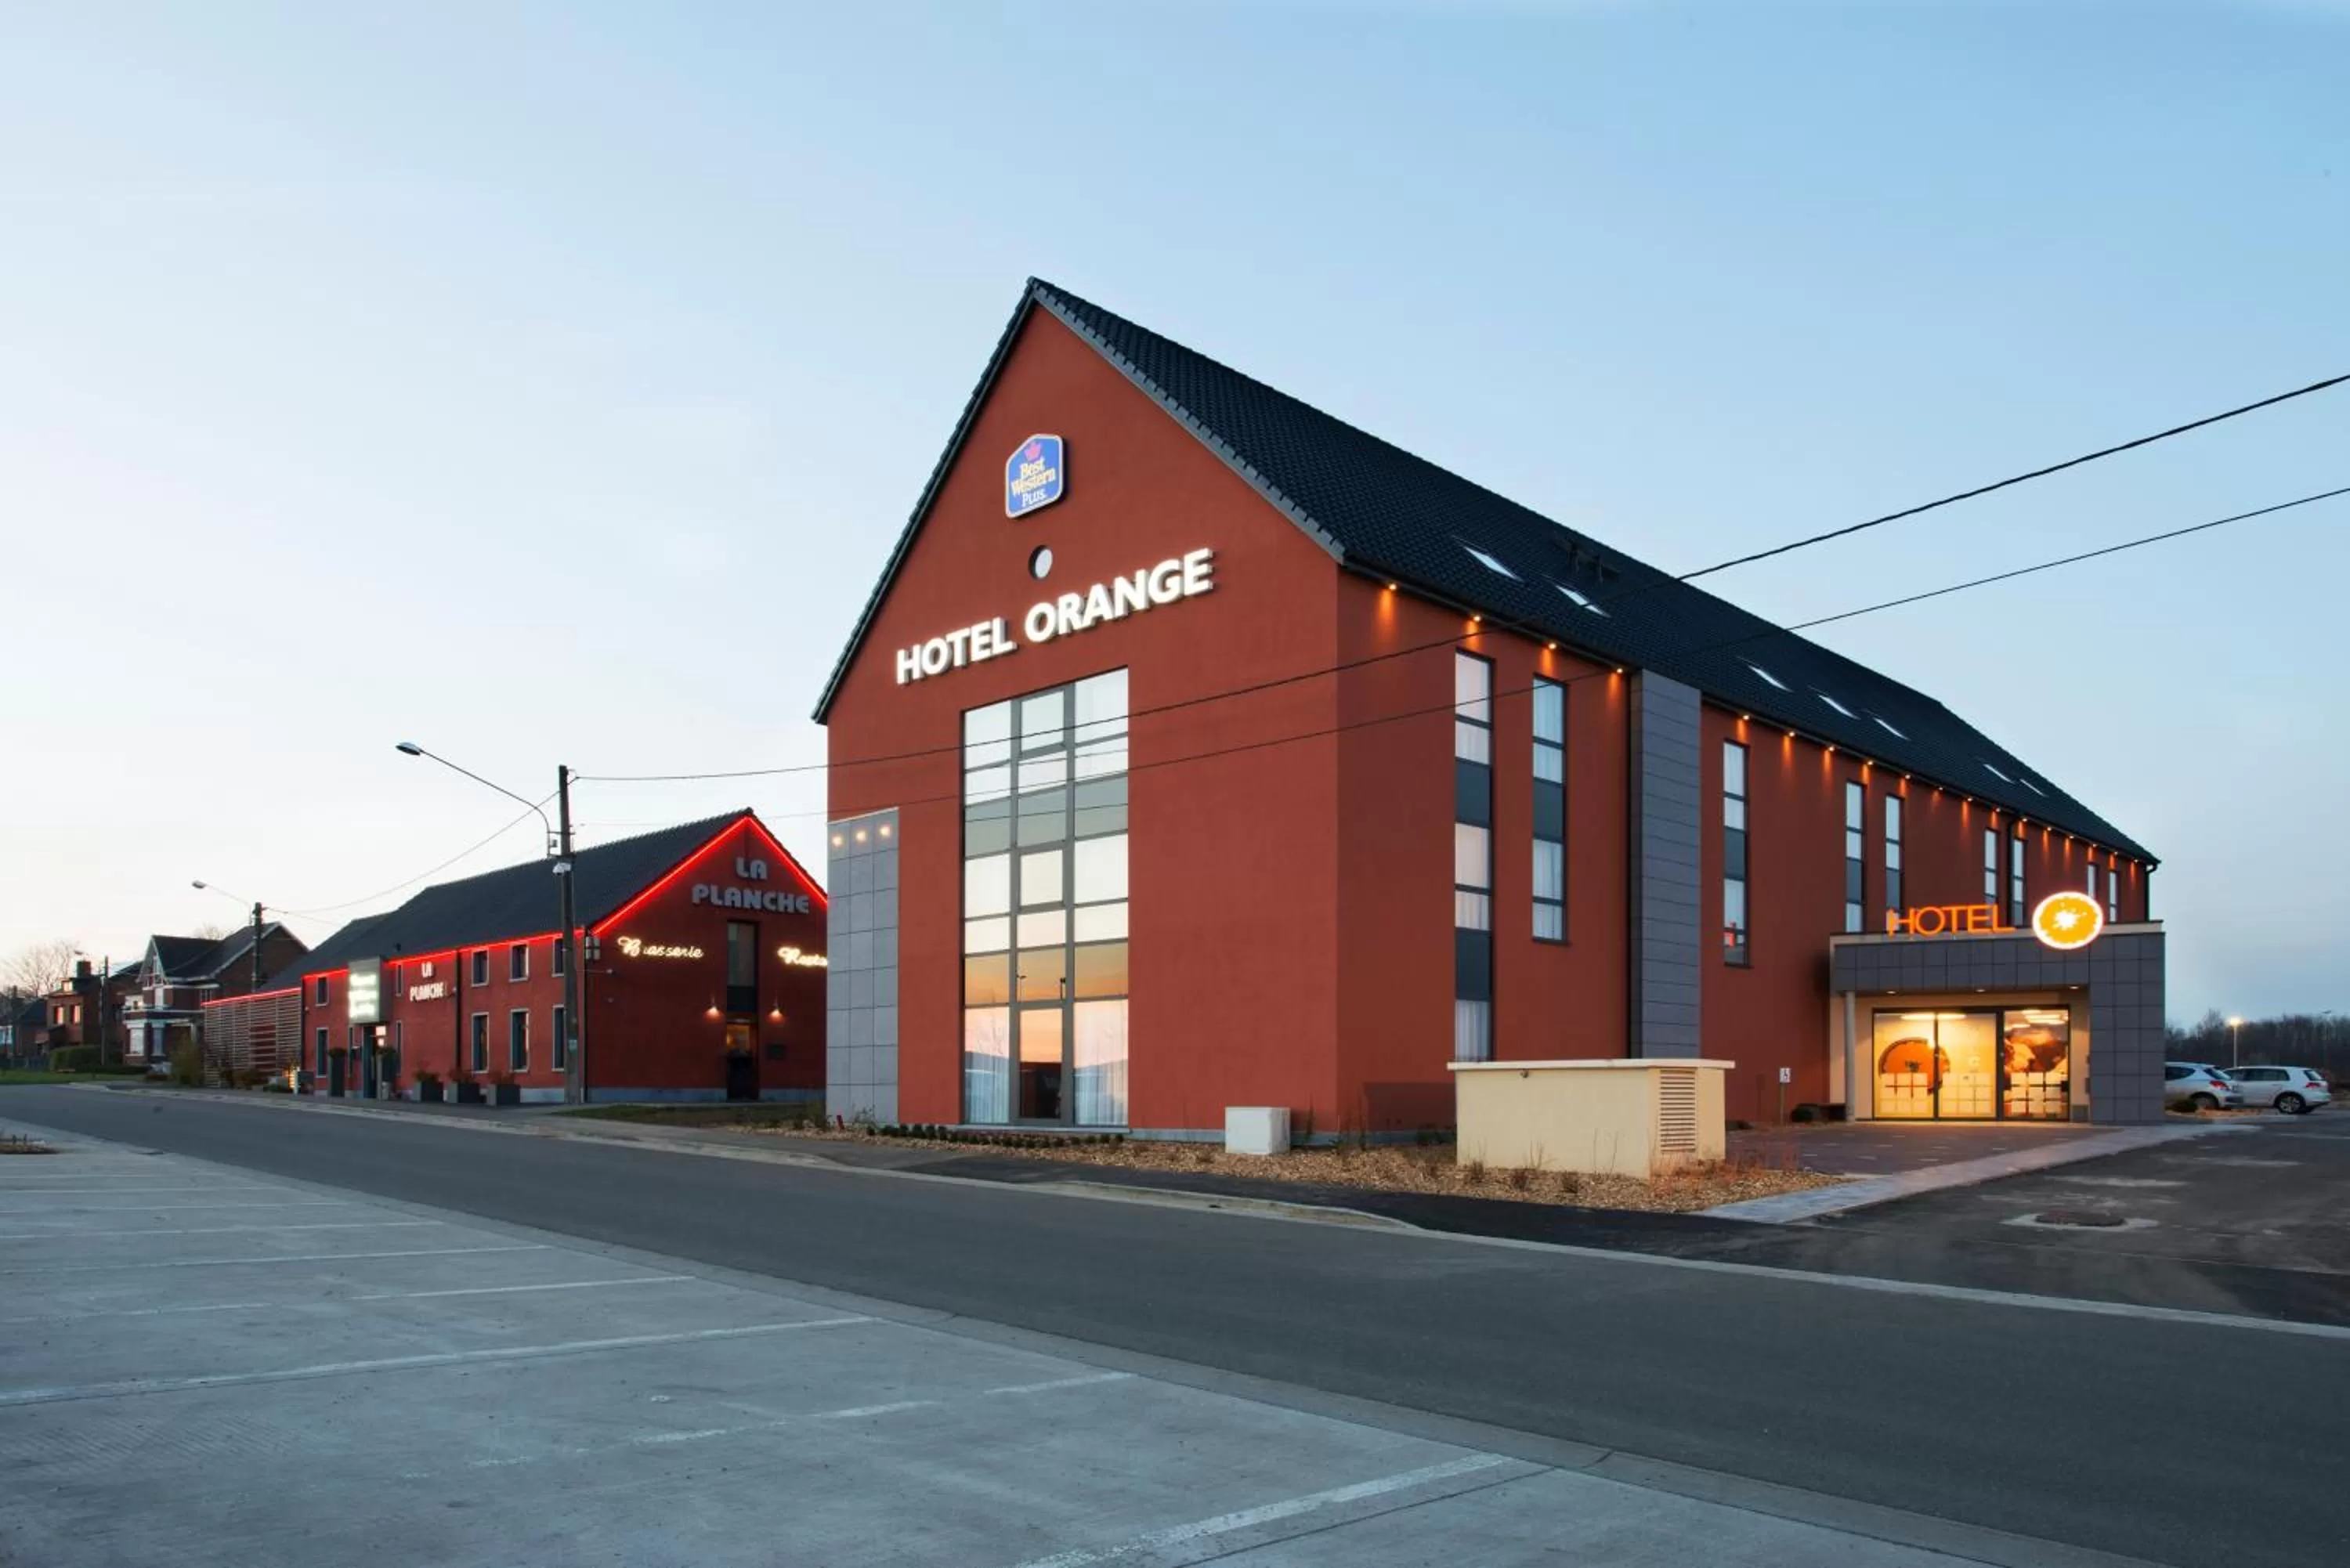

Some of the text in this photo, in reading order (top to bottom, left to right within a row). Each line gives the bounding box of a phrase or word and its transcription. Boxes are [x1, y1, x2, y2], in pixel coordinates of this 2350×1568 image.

[1011, 468, 1056, 497] Western
[1020, 457, 1045, 479] Best
[896, 547, 1213, 685] HOTEL ORANGE
[736, 857, 768, 879] LA
[692, 883, 809, 914] PLANCHE
[1887, 903, 2017, 938] HOTEL
[421, 962, 434, 977] LA
